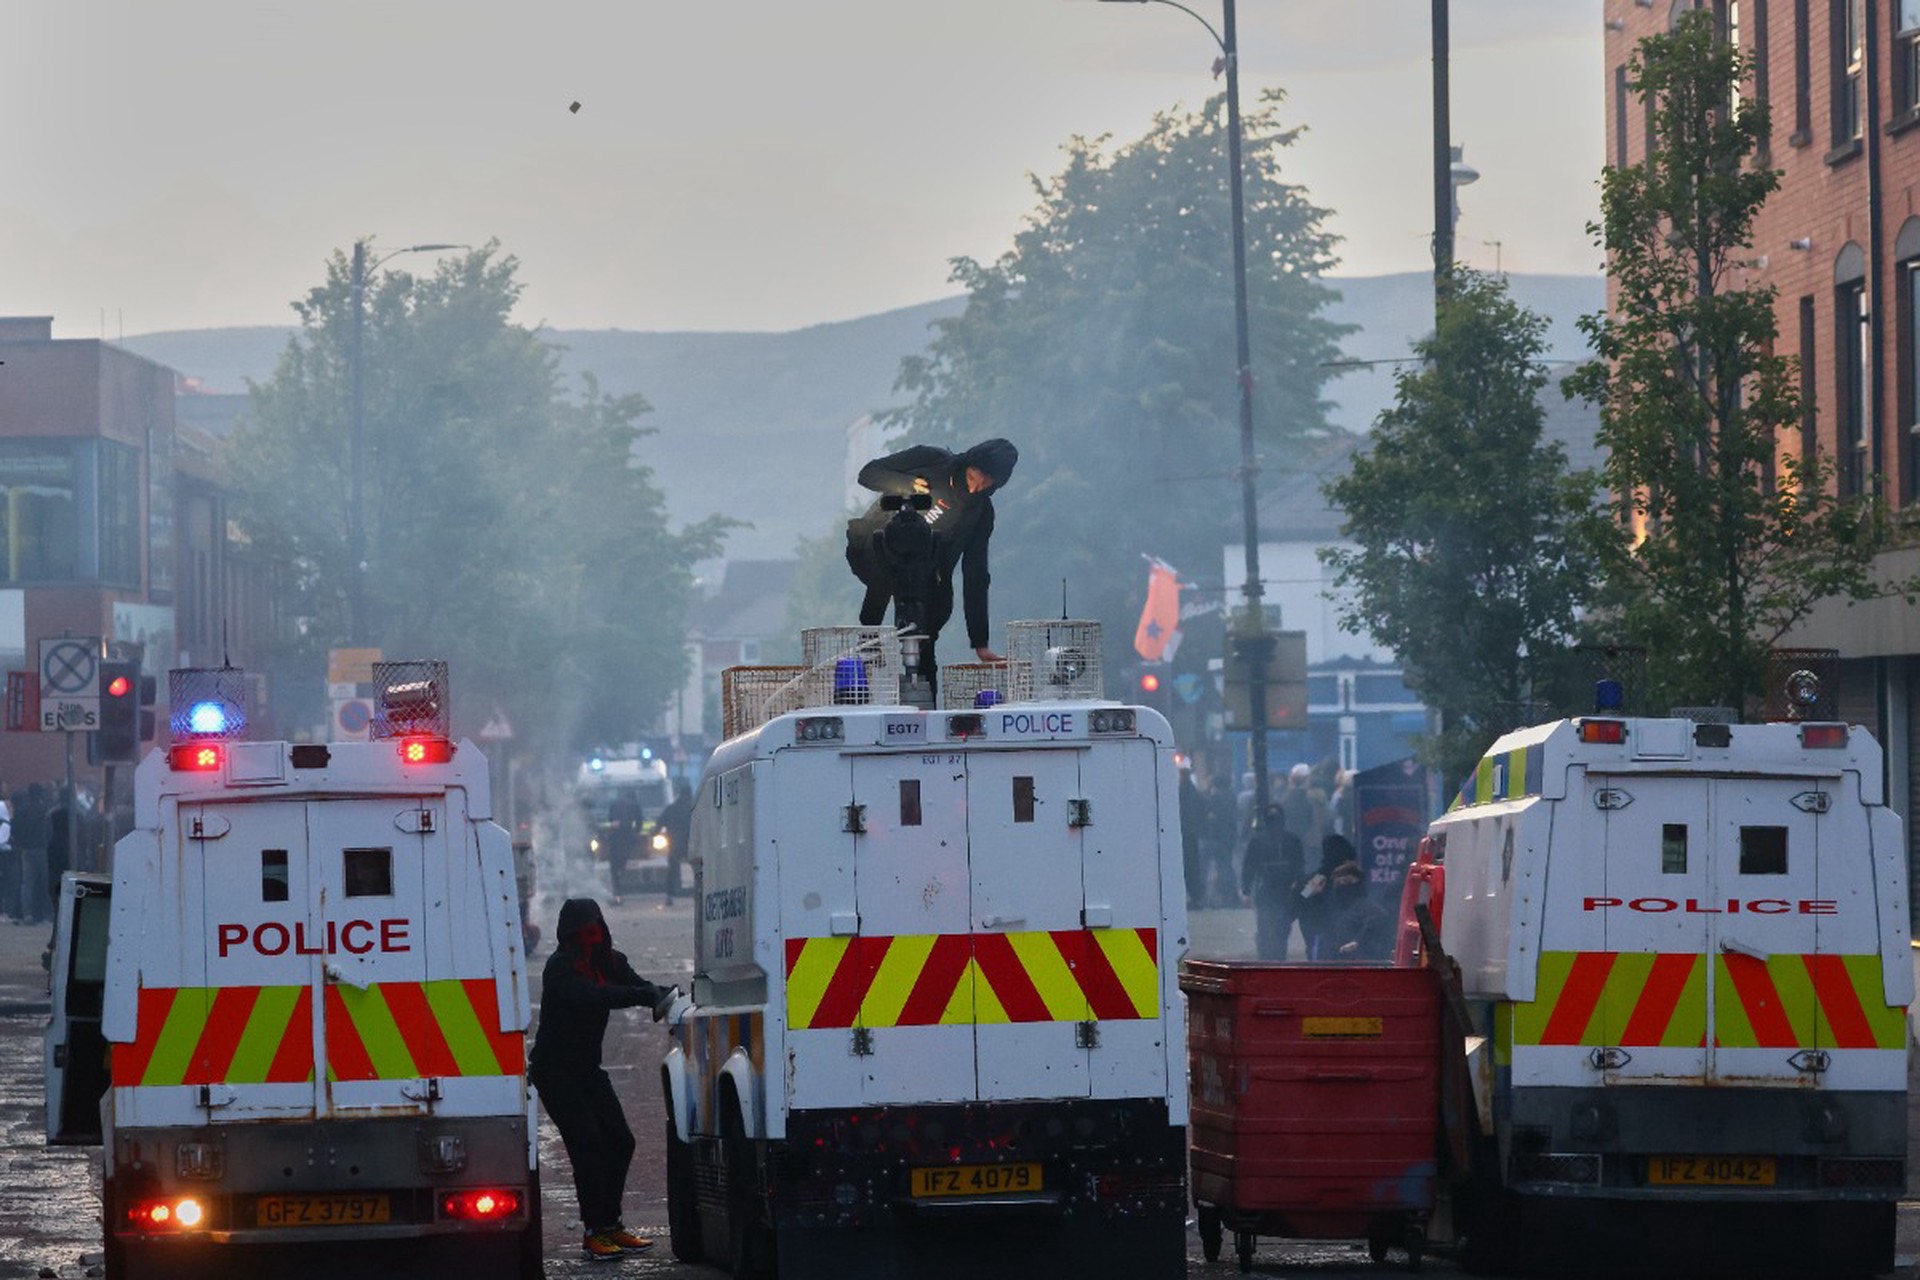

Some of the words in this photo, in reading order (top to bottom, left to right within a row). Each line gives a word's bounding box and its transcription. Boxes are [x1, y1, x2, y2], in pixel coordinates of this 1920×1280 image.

[45, 711, 96, 727] ENS
[1002, 714, 1073, 733] POLICE
[1583, 897, 1839, 914] POLICE
[217, 918, 411, 957] POLICE
[923, 1170, 961, 1191] IFZ
[971, 1166, 1030, 1189] 4079
[1703, 1159, 1762, 1181] 4042
[266, 1200, 313, 1223] GFZ
[319, 1197, 379, 1221] 3797
